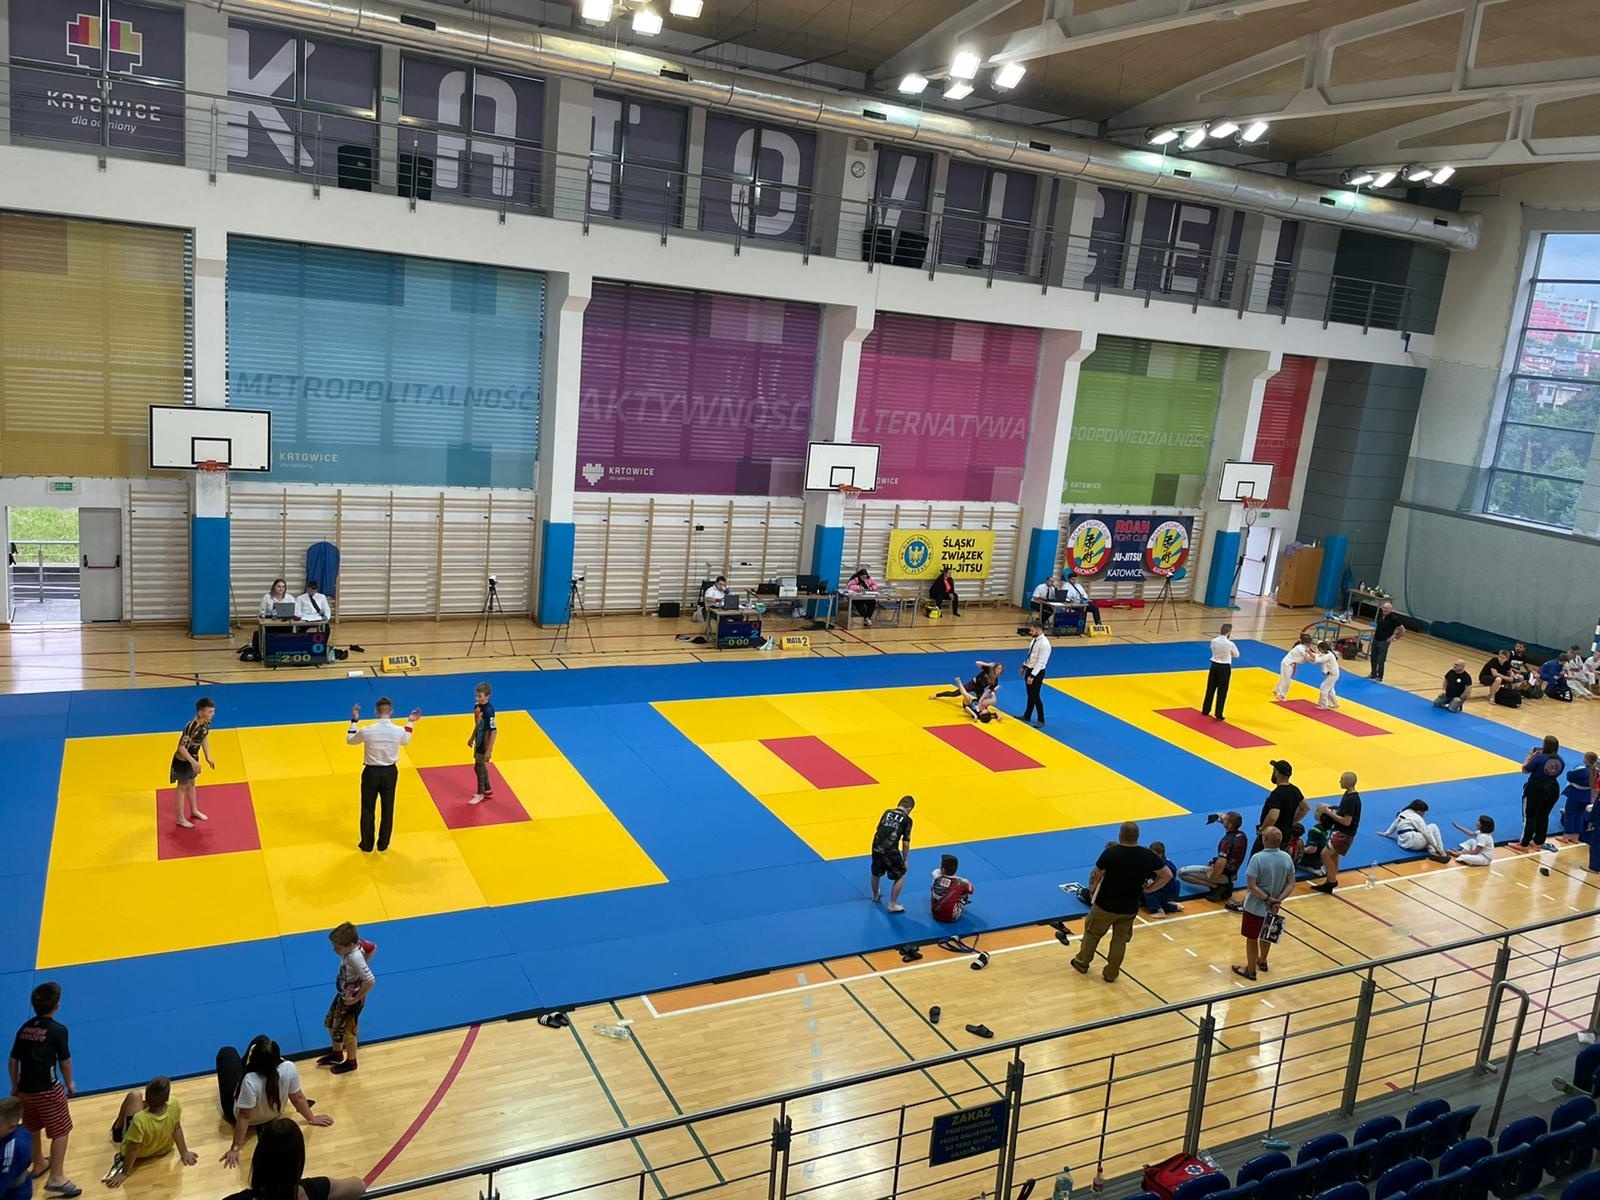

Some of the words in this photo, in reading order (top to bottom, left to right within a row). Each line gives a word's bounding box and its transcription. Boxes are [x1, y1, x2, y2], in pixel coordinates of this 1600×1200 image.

[47, 90, 161, 121] KATOWICE
[236, 371, 534, 410] METROPOLITALNOŚĆ
[579, 387, 810, 431] AKTYWNOŚĆ
[853, 408, 1026, 440] LTERNATYWA
[279, 452, 338, 463] KATOWICE
[608, 466, 655, 476] KATOWICE
[876, 477, 900, 486] OWICE
[1114, 519, 1150, 534] ROAN
[943, 536, 976, 550] ŚLĄSKI
[1113, 533, 1132, 542] FIGHT
[1132, 533, 1148, 542] CLUB
[941, 551, 984, 563] ZWIĄZEK
[1112, 552, 1143, 562] JU-JITSU
[1107, 568, 1143, 578] KATOWICE
[750, 629, 760, 639] 2
[1105, 626, 1110, 635] 1
[801, 637, 809, 646] 2
[312, 643, 325, 654] 0
[388, 655, 409, 665] MATA
[409, 655, 417, 667] 3
[951, 1106, 992, 1126] ZAKAZ
